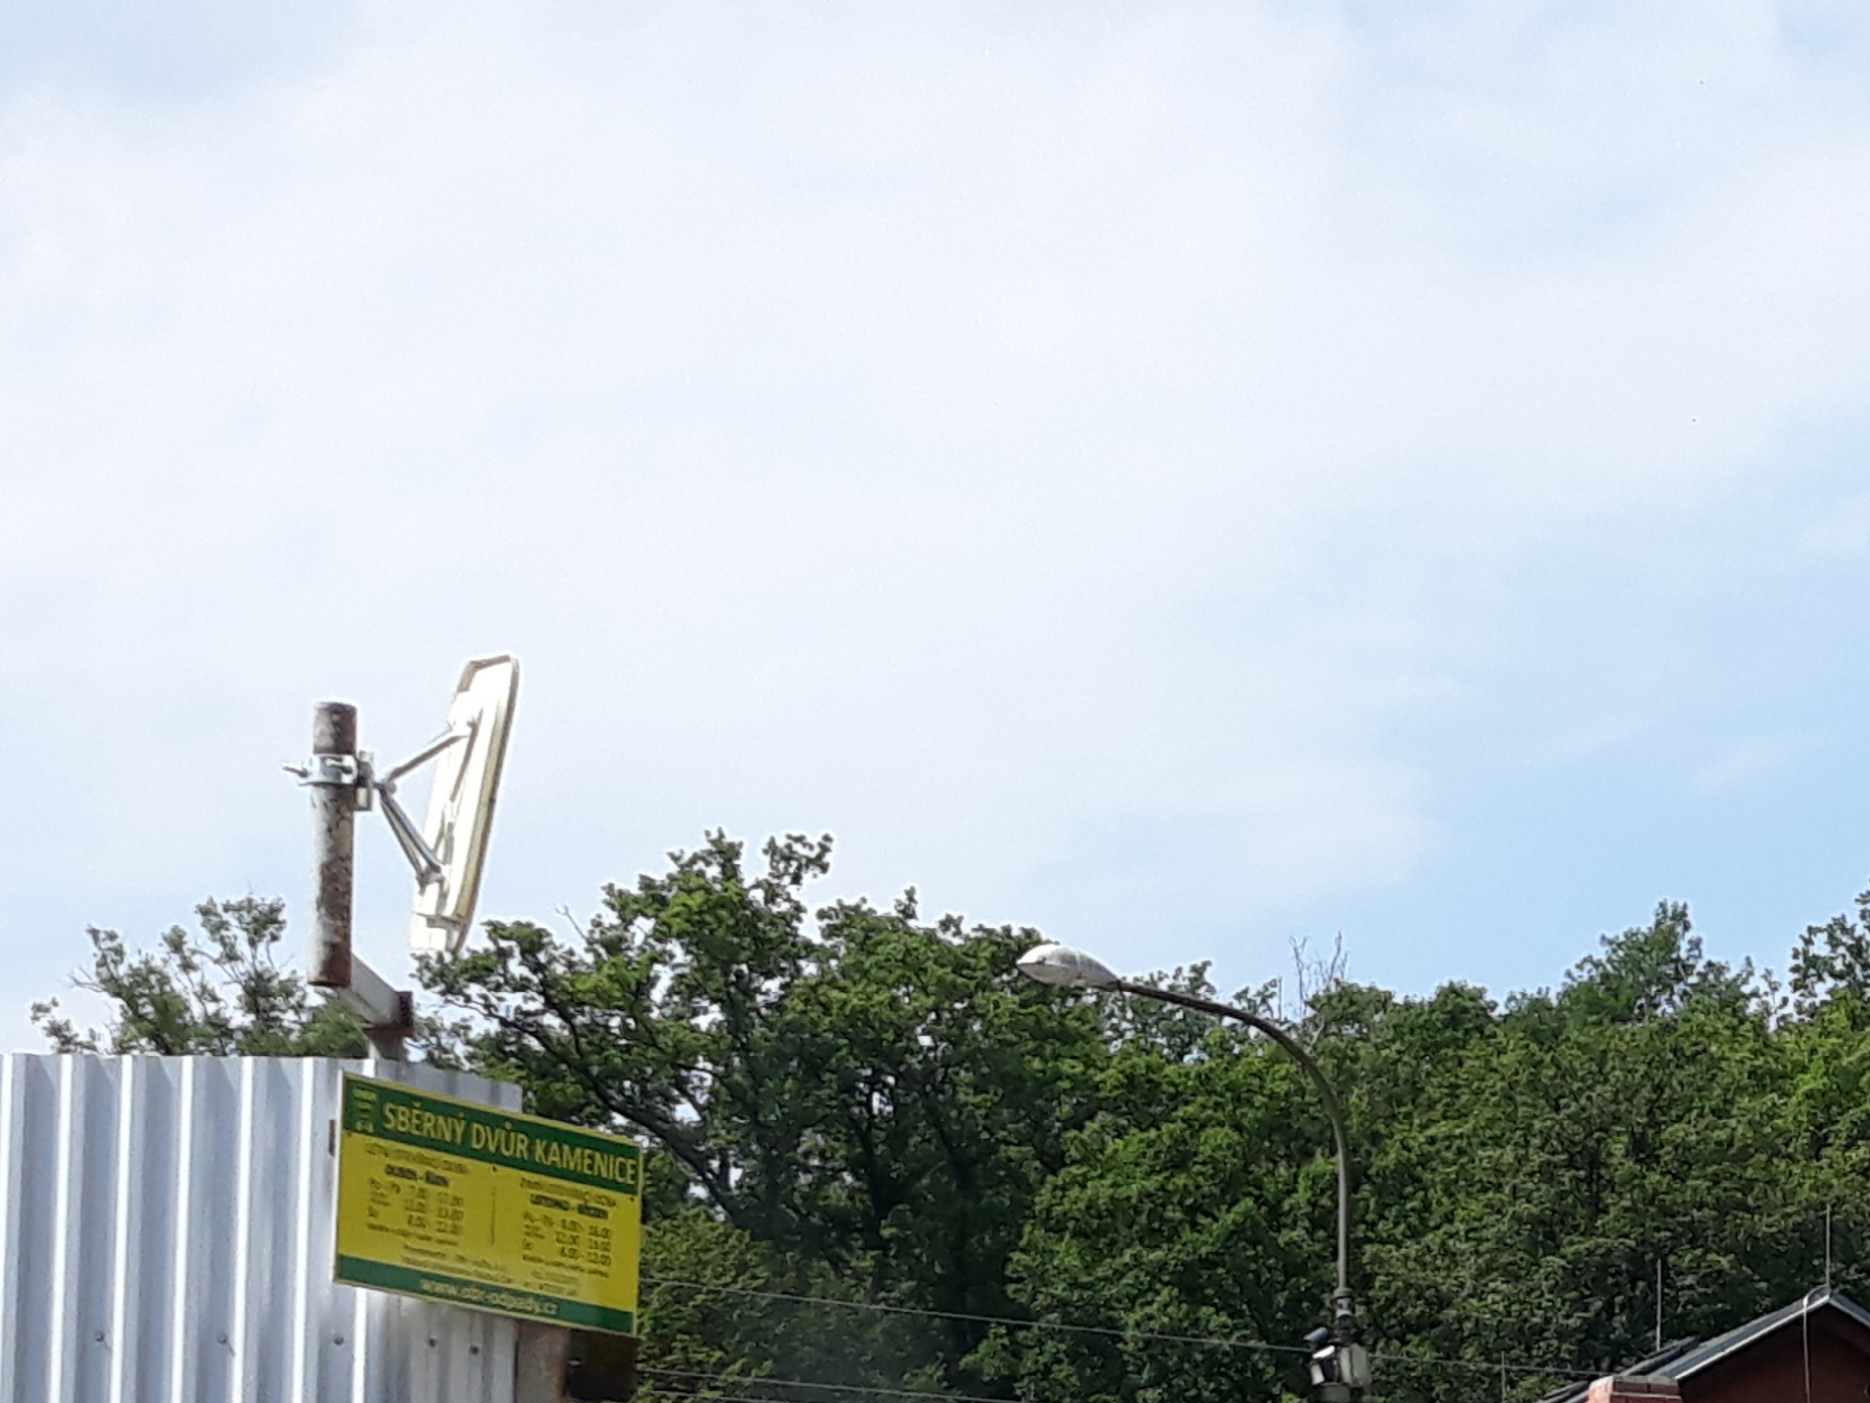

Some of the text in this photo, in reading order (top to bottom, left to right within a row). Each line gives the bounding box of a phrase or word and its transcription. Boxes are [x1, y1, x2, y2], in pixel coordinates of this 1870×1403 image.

[382, 1100, 467, 1144] SBĚRNÝ
[471, 1121, 528, 1160] DVŮR
[535, 1138, 637, 1185] KAMENICE
